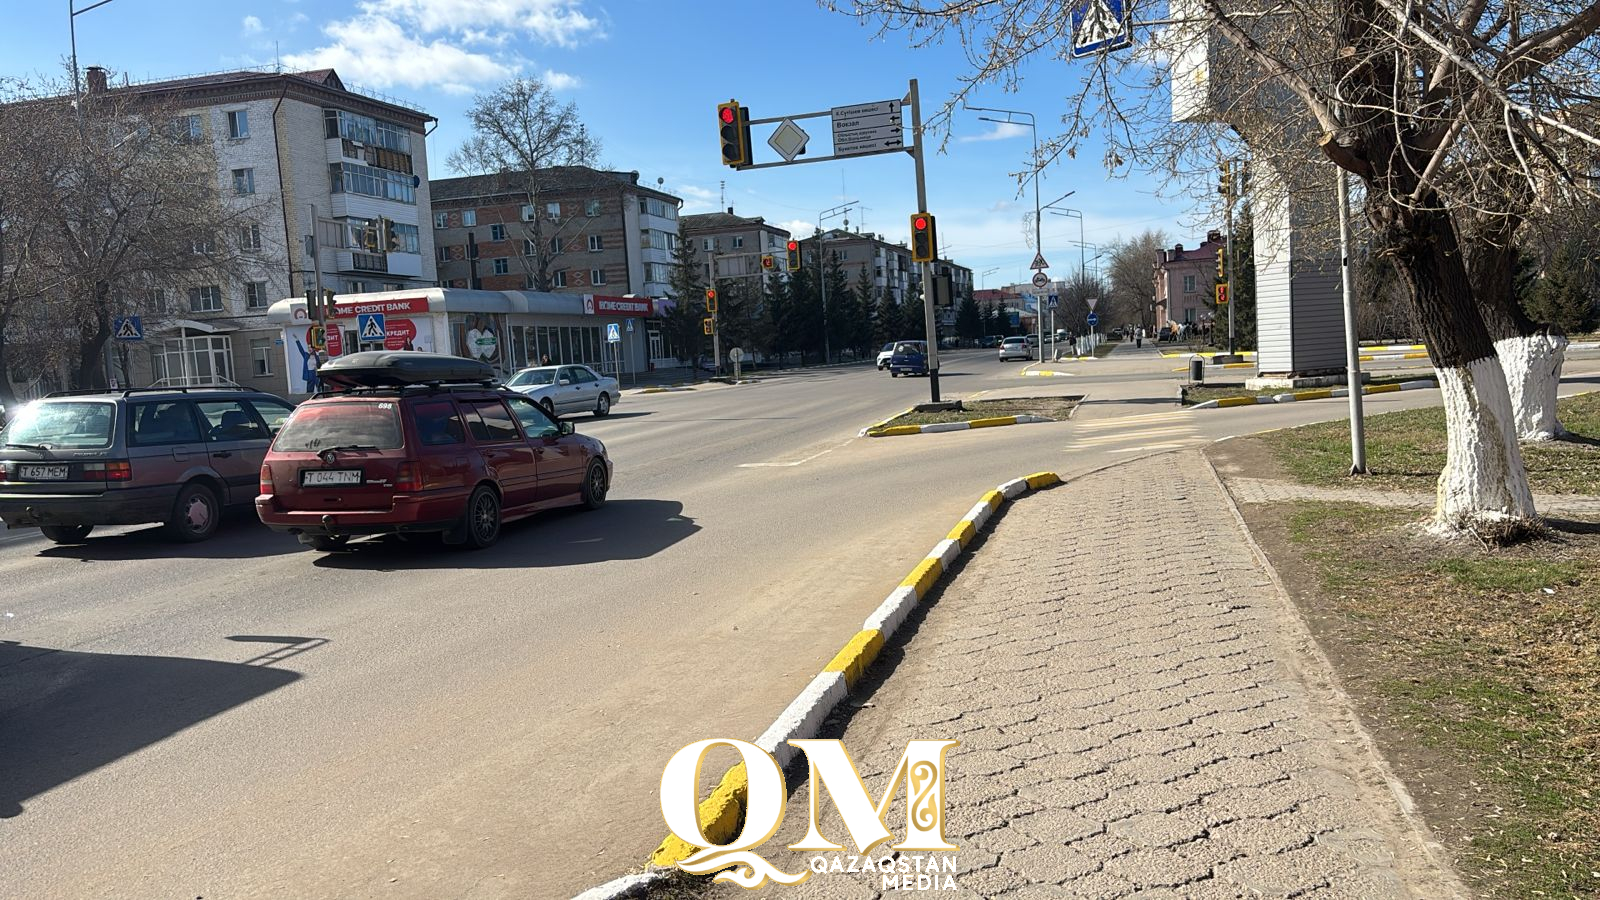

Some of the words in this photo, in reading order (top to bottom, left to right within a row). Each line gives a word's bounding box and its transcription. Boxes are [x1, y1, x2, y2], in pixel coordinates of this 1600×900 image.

[354, 304, 385, 313] CREDIT
[386, 302, 411, 311] BANK
[599, 301, 616, 310] HOME
[616, 302, 634, 311] CREDIT
[634, 303, 649, 312] BANK
[23, 466, 30, 476] T
[30, 466, 46, 477] 657
[48, 466, 66, 477] MEM
[307, 472, 315, 482] T
[317, 471, 334, 482] 044
[338, 472, 360, 482] TNM
